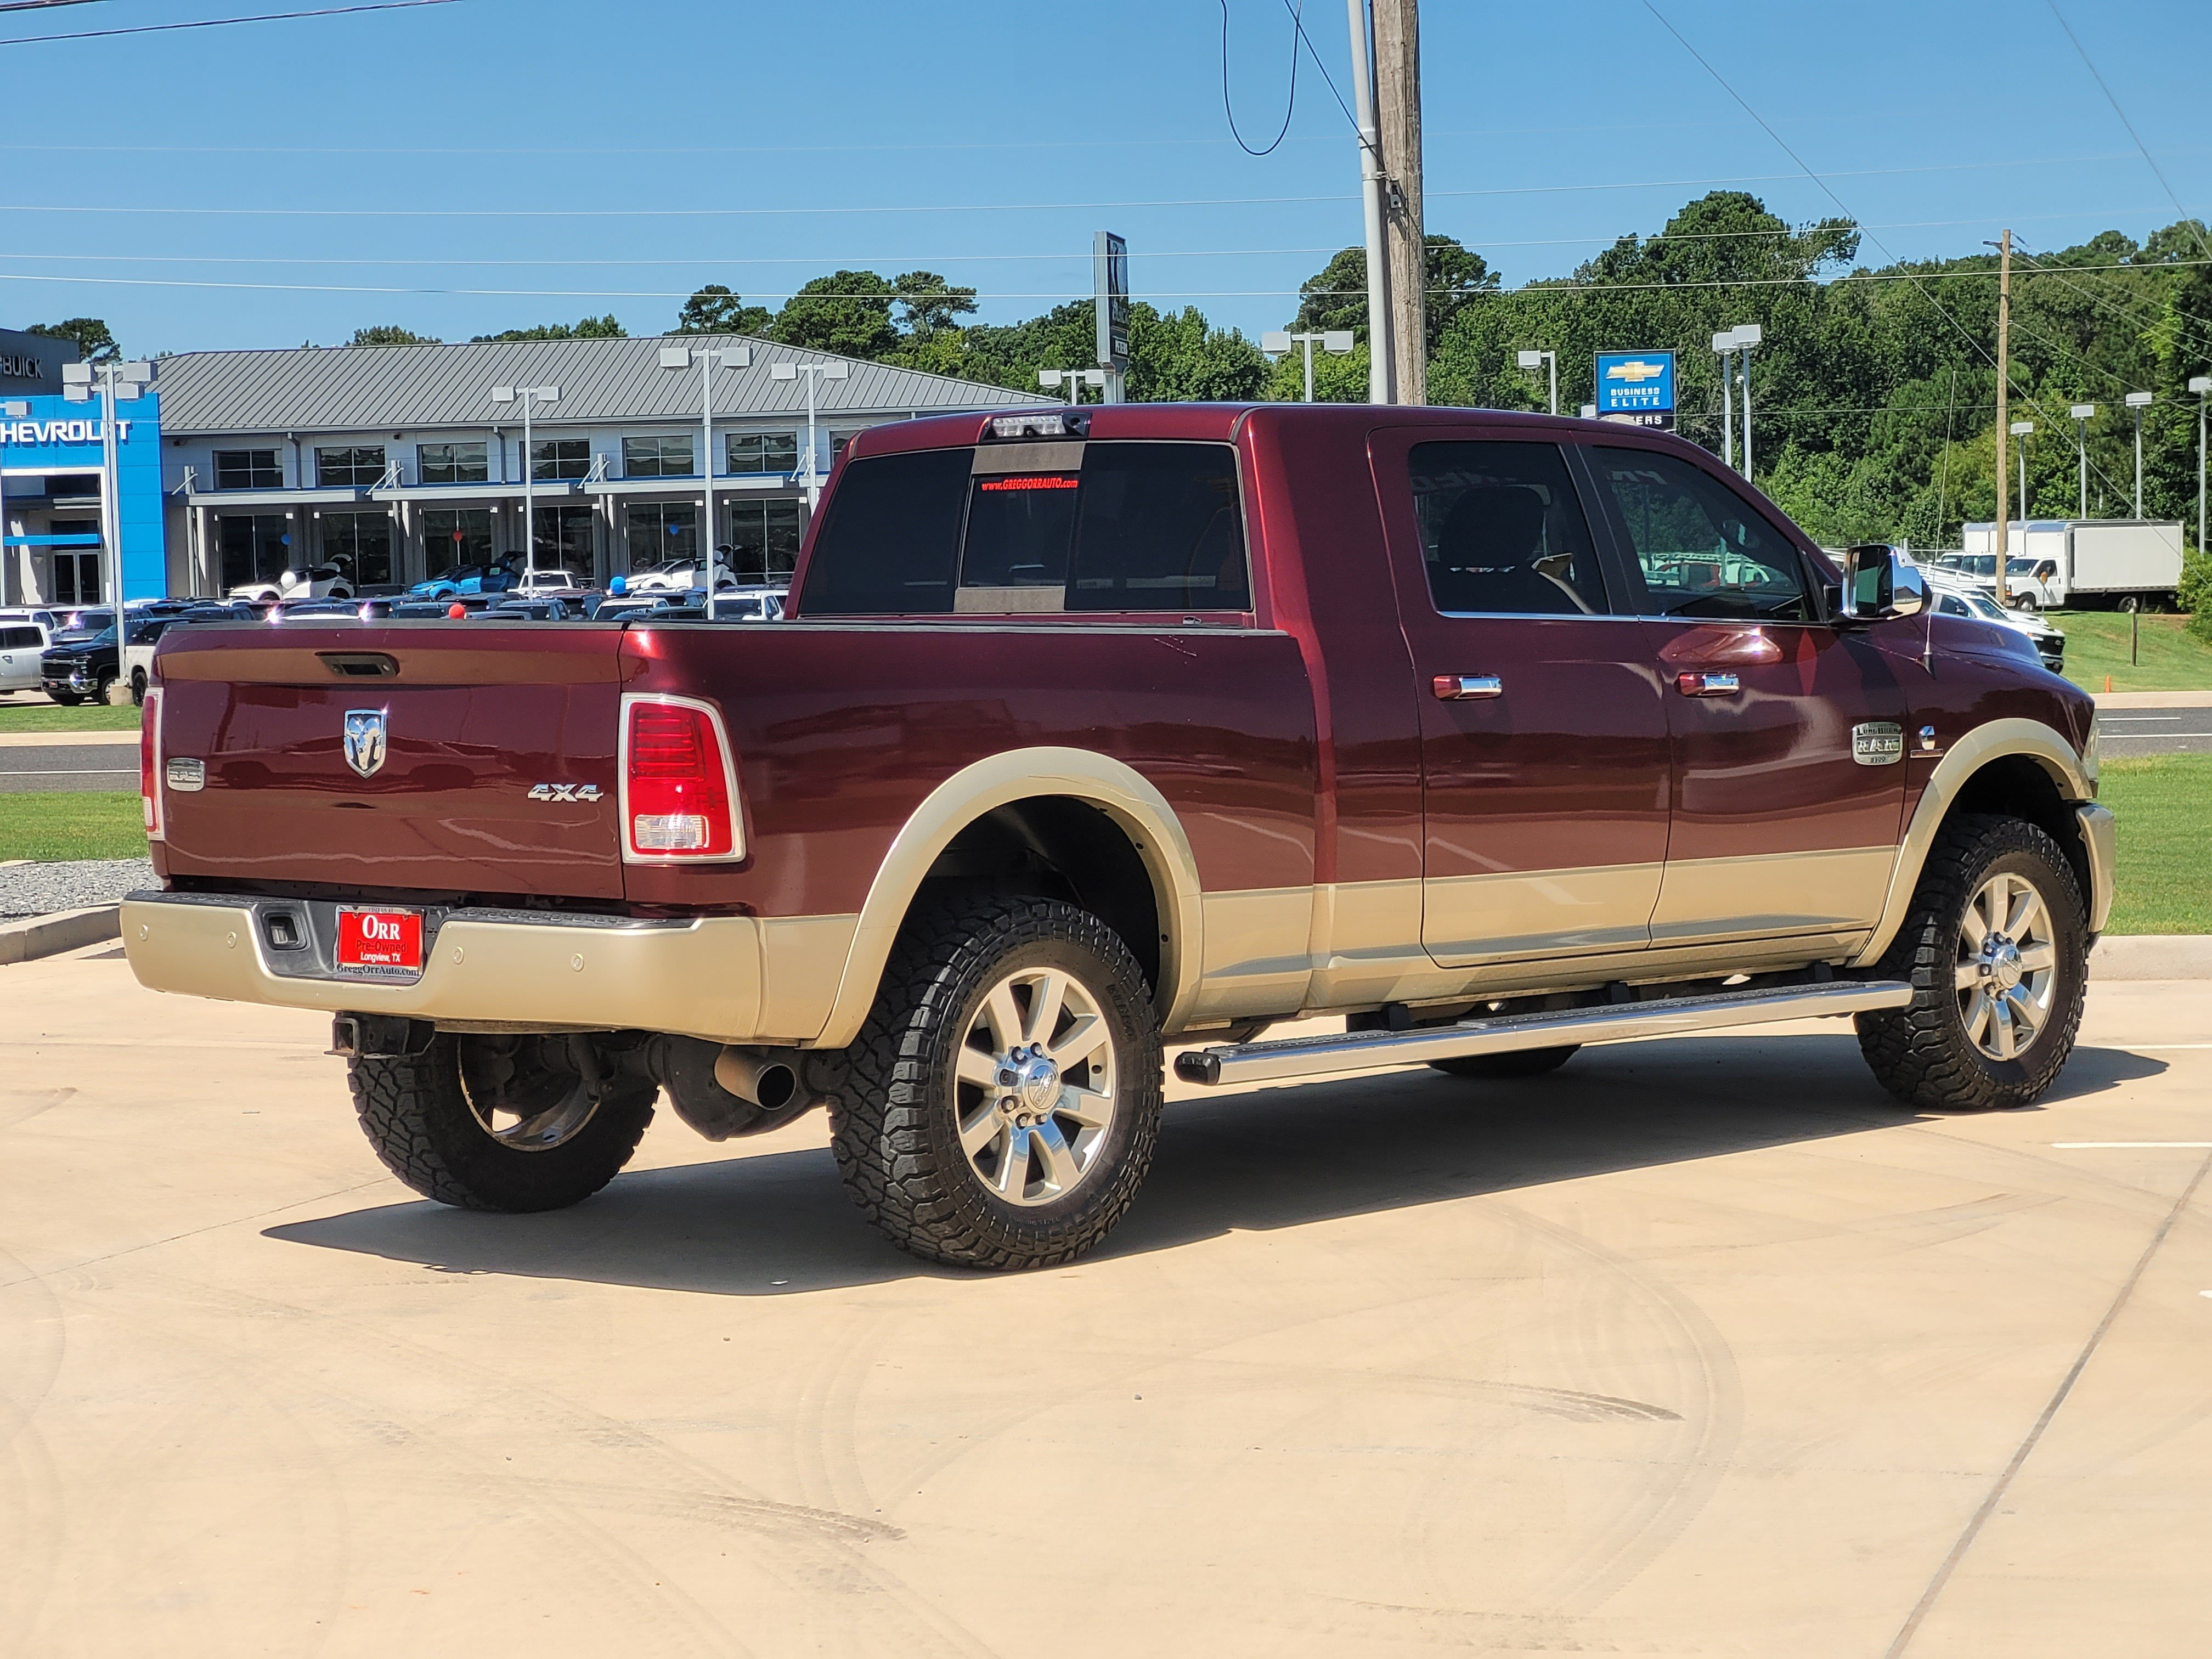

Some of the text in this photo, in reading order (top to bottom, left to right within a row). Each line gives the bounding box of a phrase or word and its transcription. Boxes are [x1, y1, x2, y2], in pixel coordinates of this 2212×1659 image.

[3, 356, 44, 379] BUICK
[1610, 387, 1660, 396] BUSINESS
[1611, 397, 1660, 407] ELITE
[1631, 415, 1662, 425] ERS
[981, 477, 1078, 491] www.GREGGORRAUTO.com
[1857, 738, 1899, 753] RAM
[357, 940, 407, 953] Pre-Owned
[360, 952, 400, 963] Longview, TX
[336, 964, 420, 977] GreggOrrAuto.com
